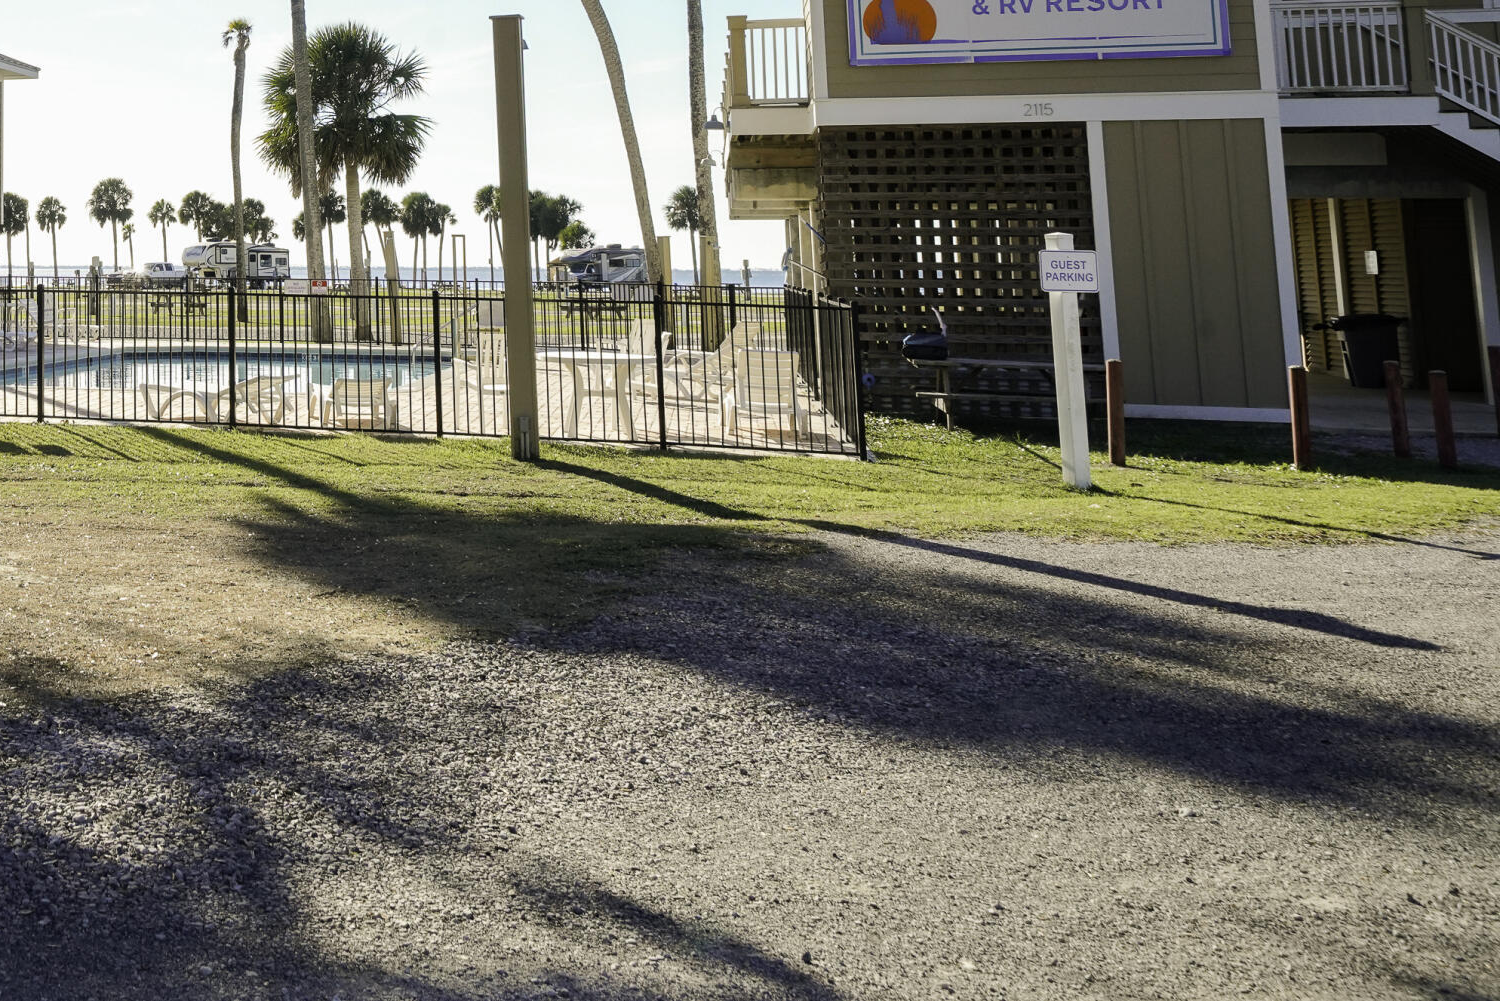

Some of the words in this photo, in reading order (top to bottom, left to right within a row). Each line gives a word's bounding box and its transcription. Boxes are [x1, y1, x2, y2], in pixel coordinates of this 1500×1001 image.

[1022, 102, 1054, 117] 2115
[1050, 260, 1087, 270] GUEST
[1045, 272, 1094, 282] PARKING
